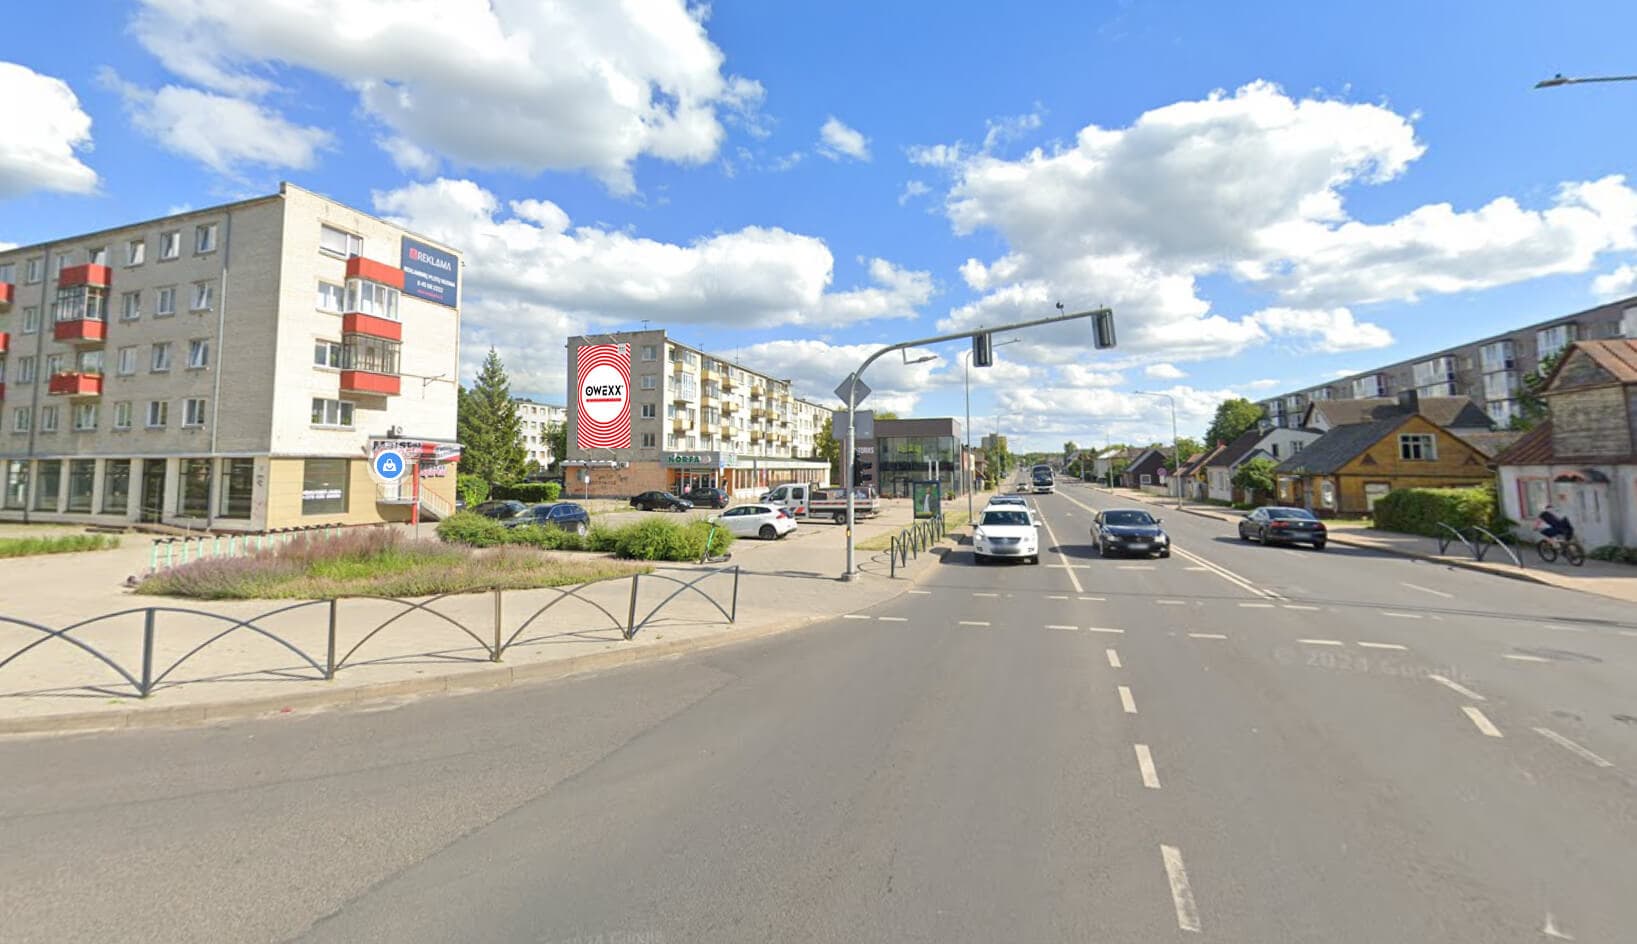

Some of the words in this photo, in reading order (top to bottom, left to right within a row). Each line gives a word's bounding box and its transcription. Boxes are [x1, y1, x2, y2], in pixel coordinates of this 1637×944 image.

[417, 252, 452, 271] REKLAMA
[585, 385, 622, 397] OWEXX
[668, 456, 700, 464] NORFA
